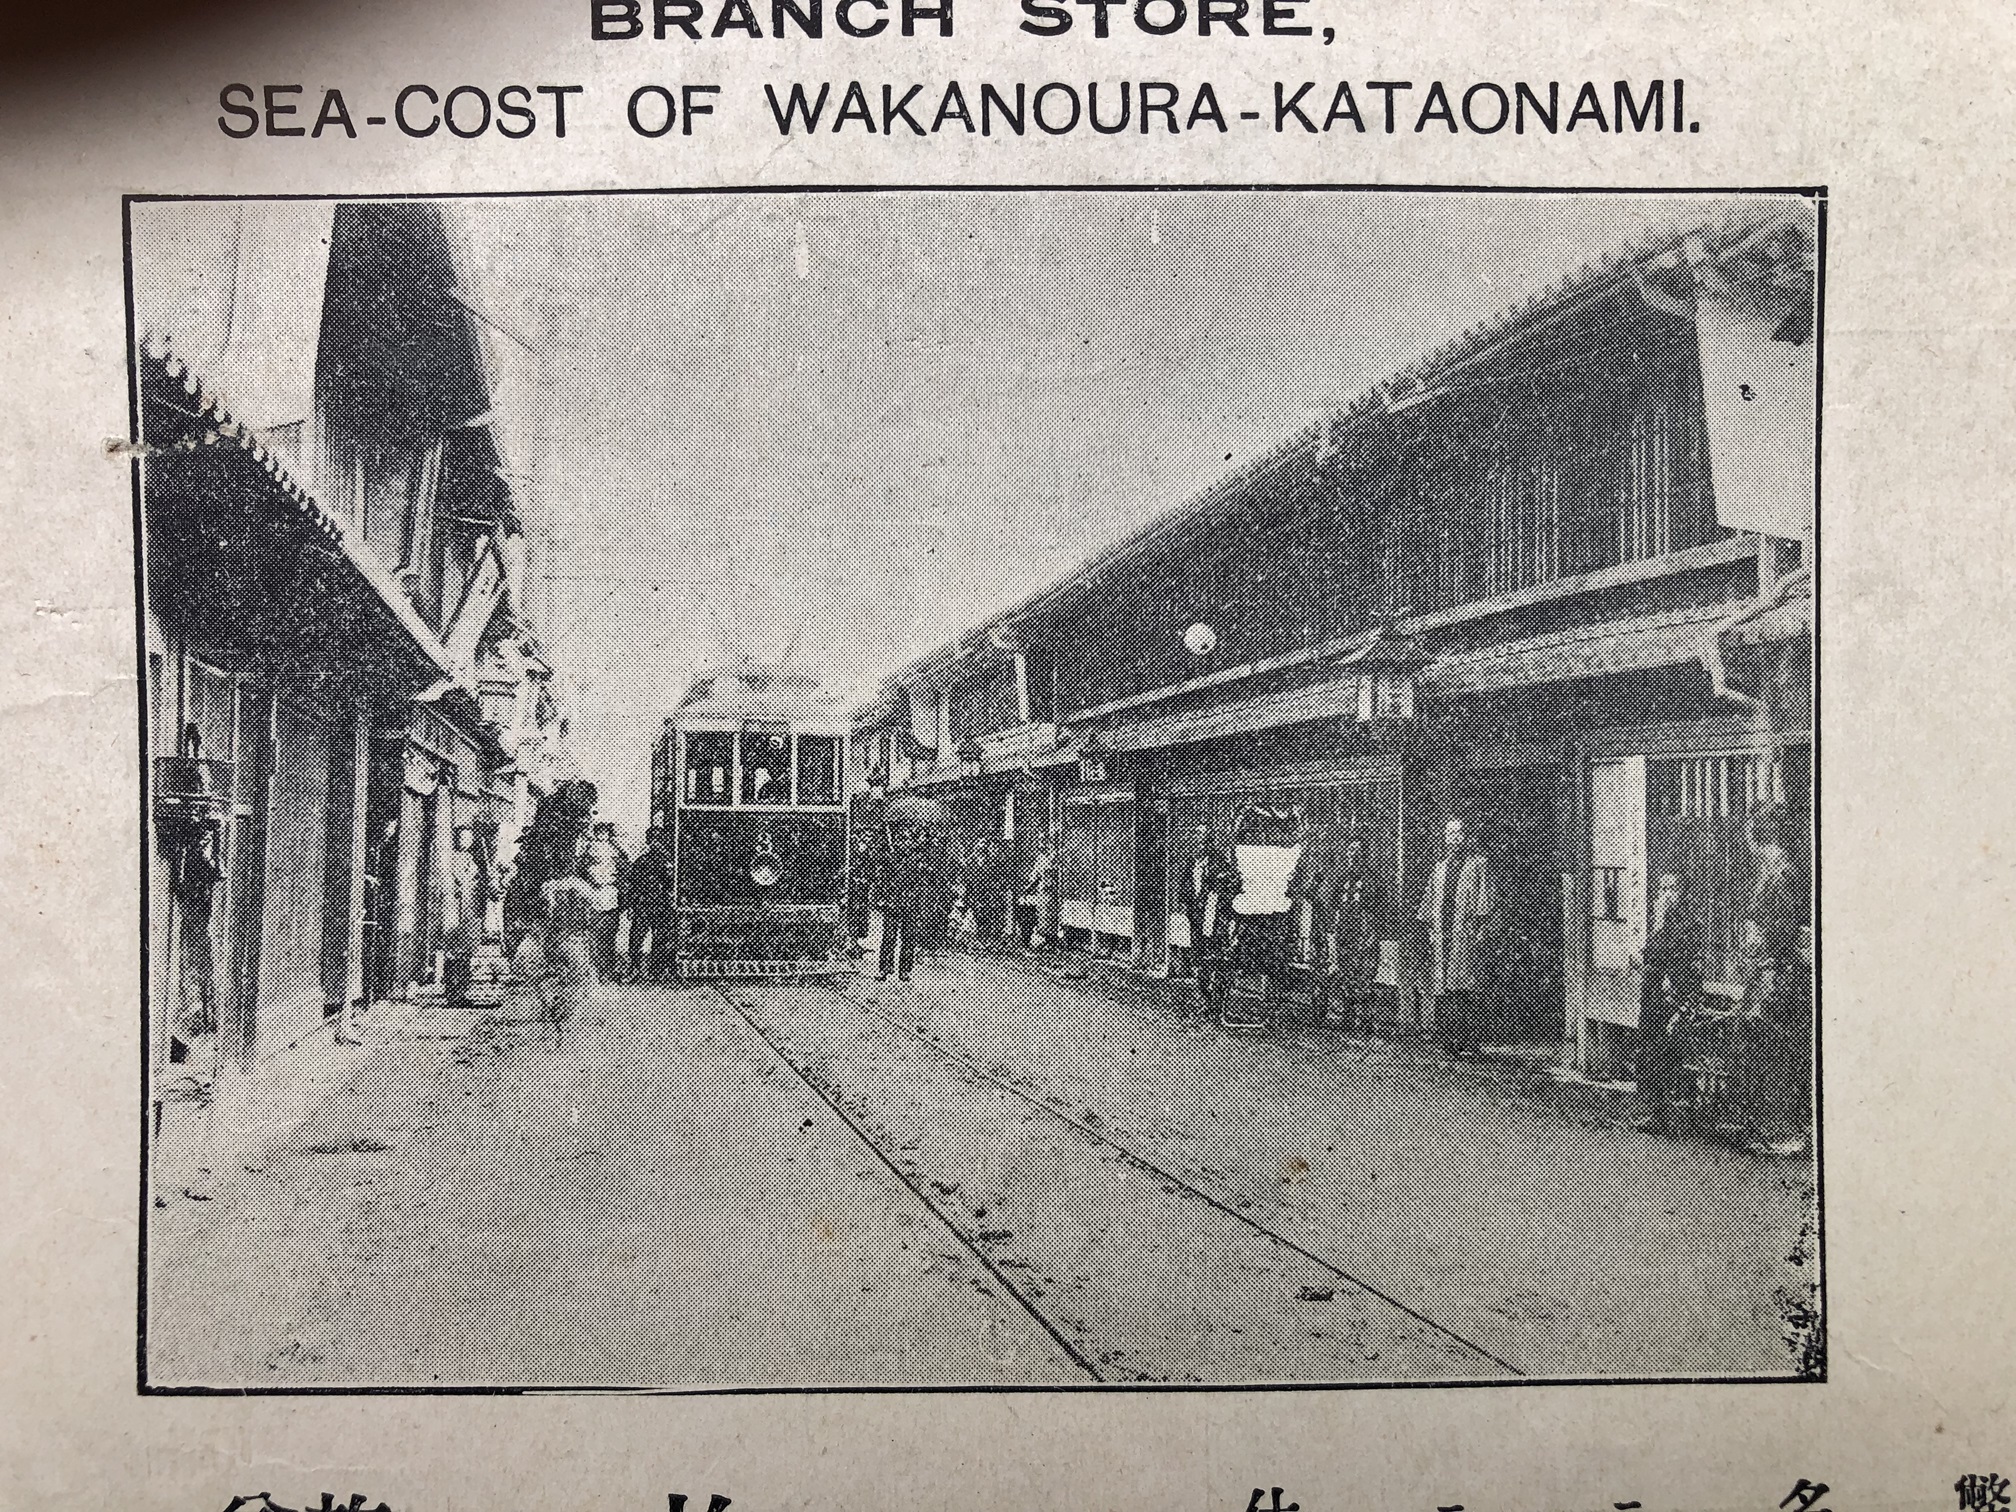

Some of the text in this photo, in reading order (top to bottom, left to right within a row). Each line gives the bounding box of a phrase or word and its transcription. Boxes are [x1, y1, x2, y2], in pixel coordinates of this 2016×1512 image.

[590, 0, 1336, 46] BRANCH STORE,
[217, 79, 1701, 140] SEA-COST OF WAKANOURA-KATAONAMI.
